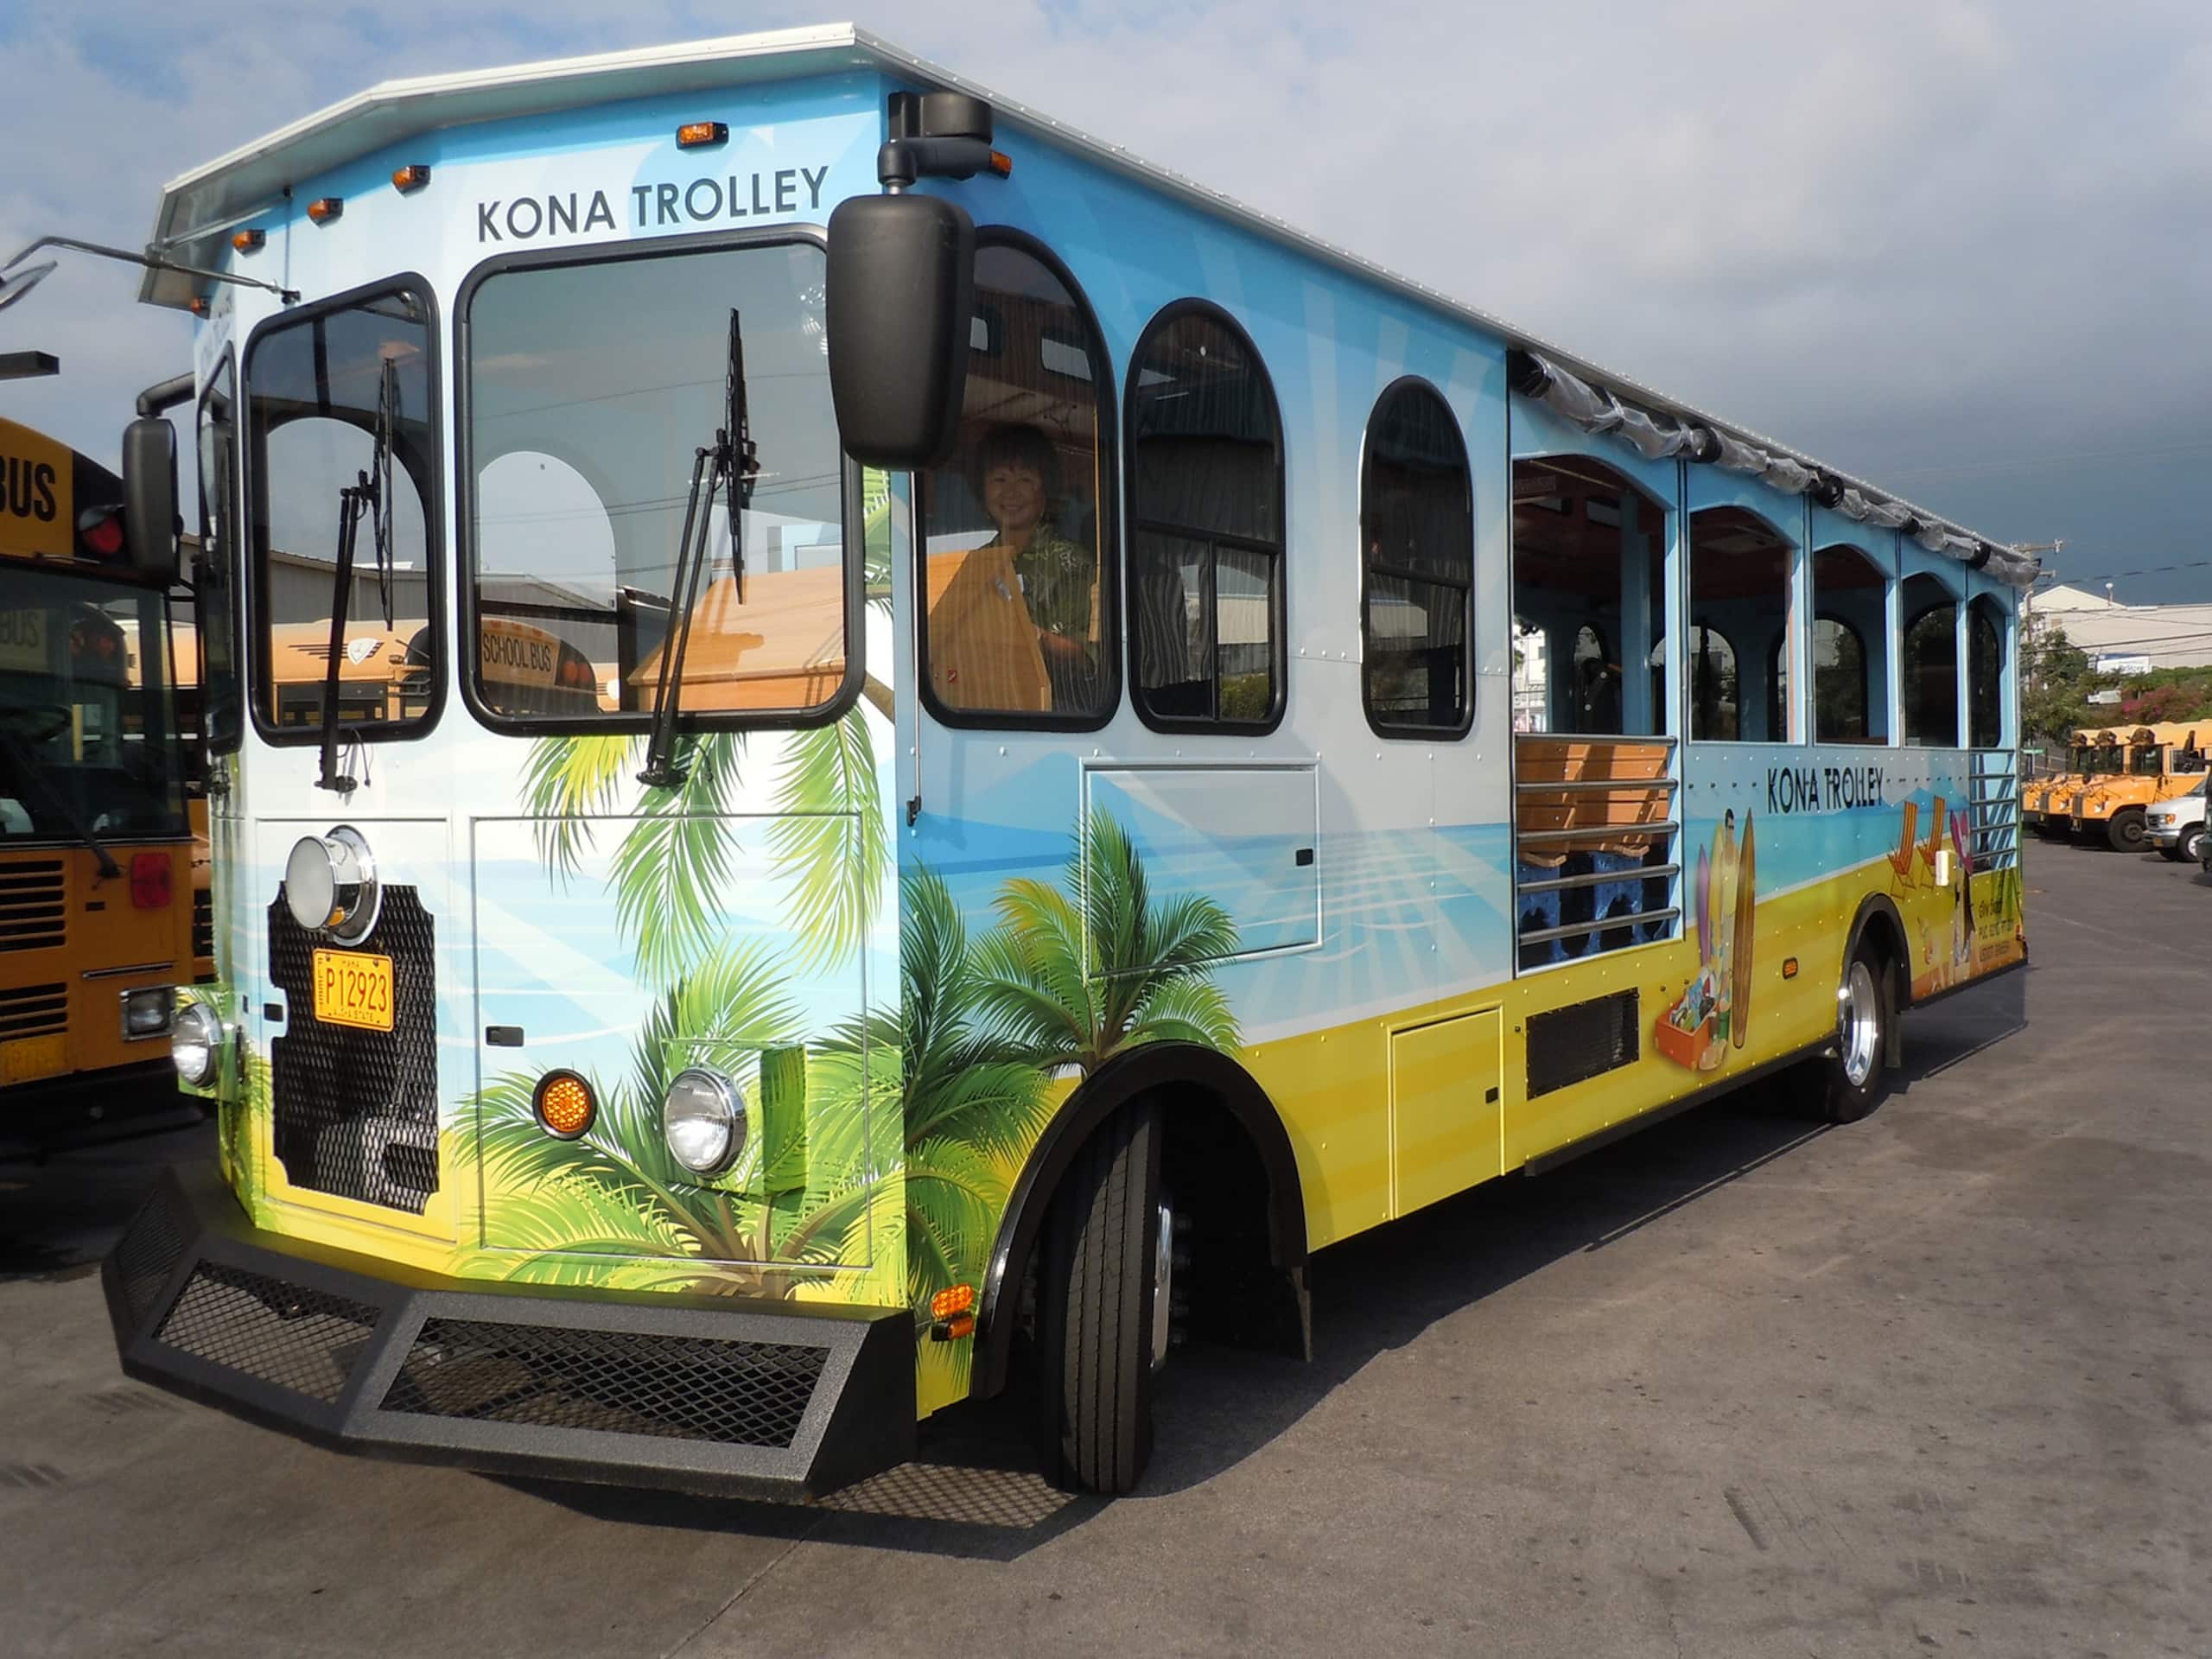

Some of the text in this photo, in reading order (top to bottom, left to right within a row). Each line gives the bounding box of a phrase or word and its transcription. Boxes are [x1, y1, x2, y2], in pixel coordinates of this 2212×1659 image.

[478, 166, 829, 243] KONA TROLLEY
[0, 454, 56, 522] US
[484, 632, 551, 672] SCHOOL BUS
[1768, 767, 1883, 814] KONA TROLLEY
[326, 968, 387, 1013] P12923
